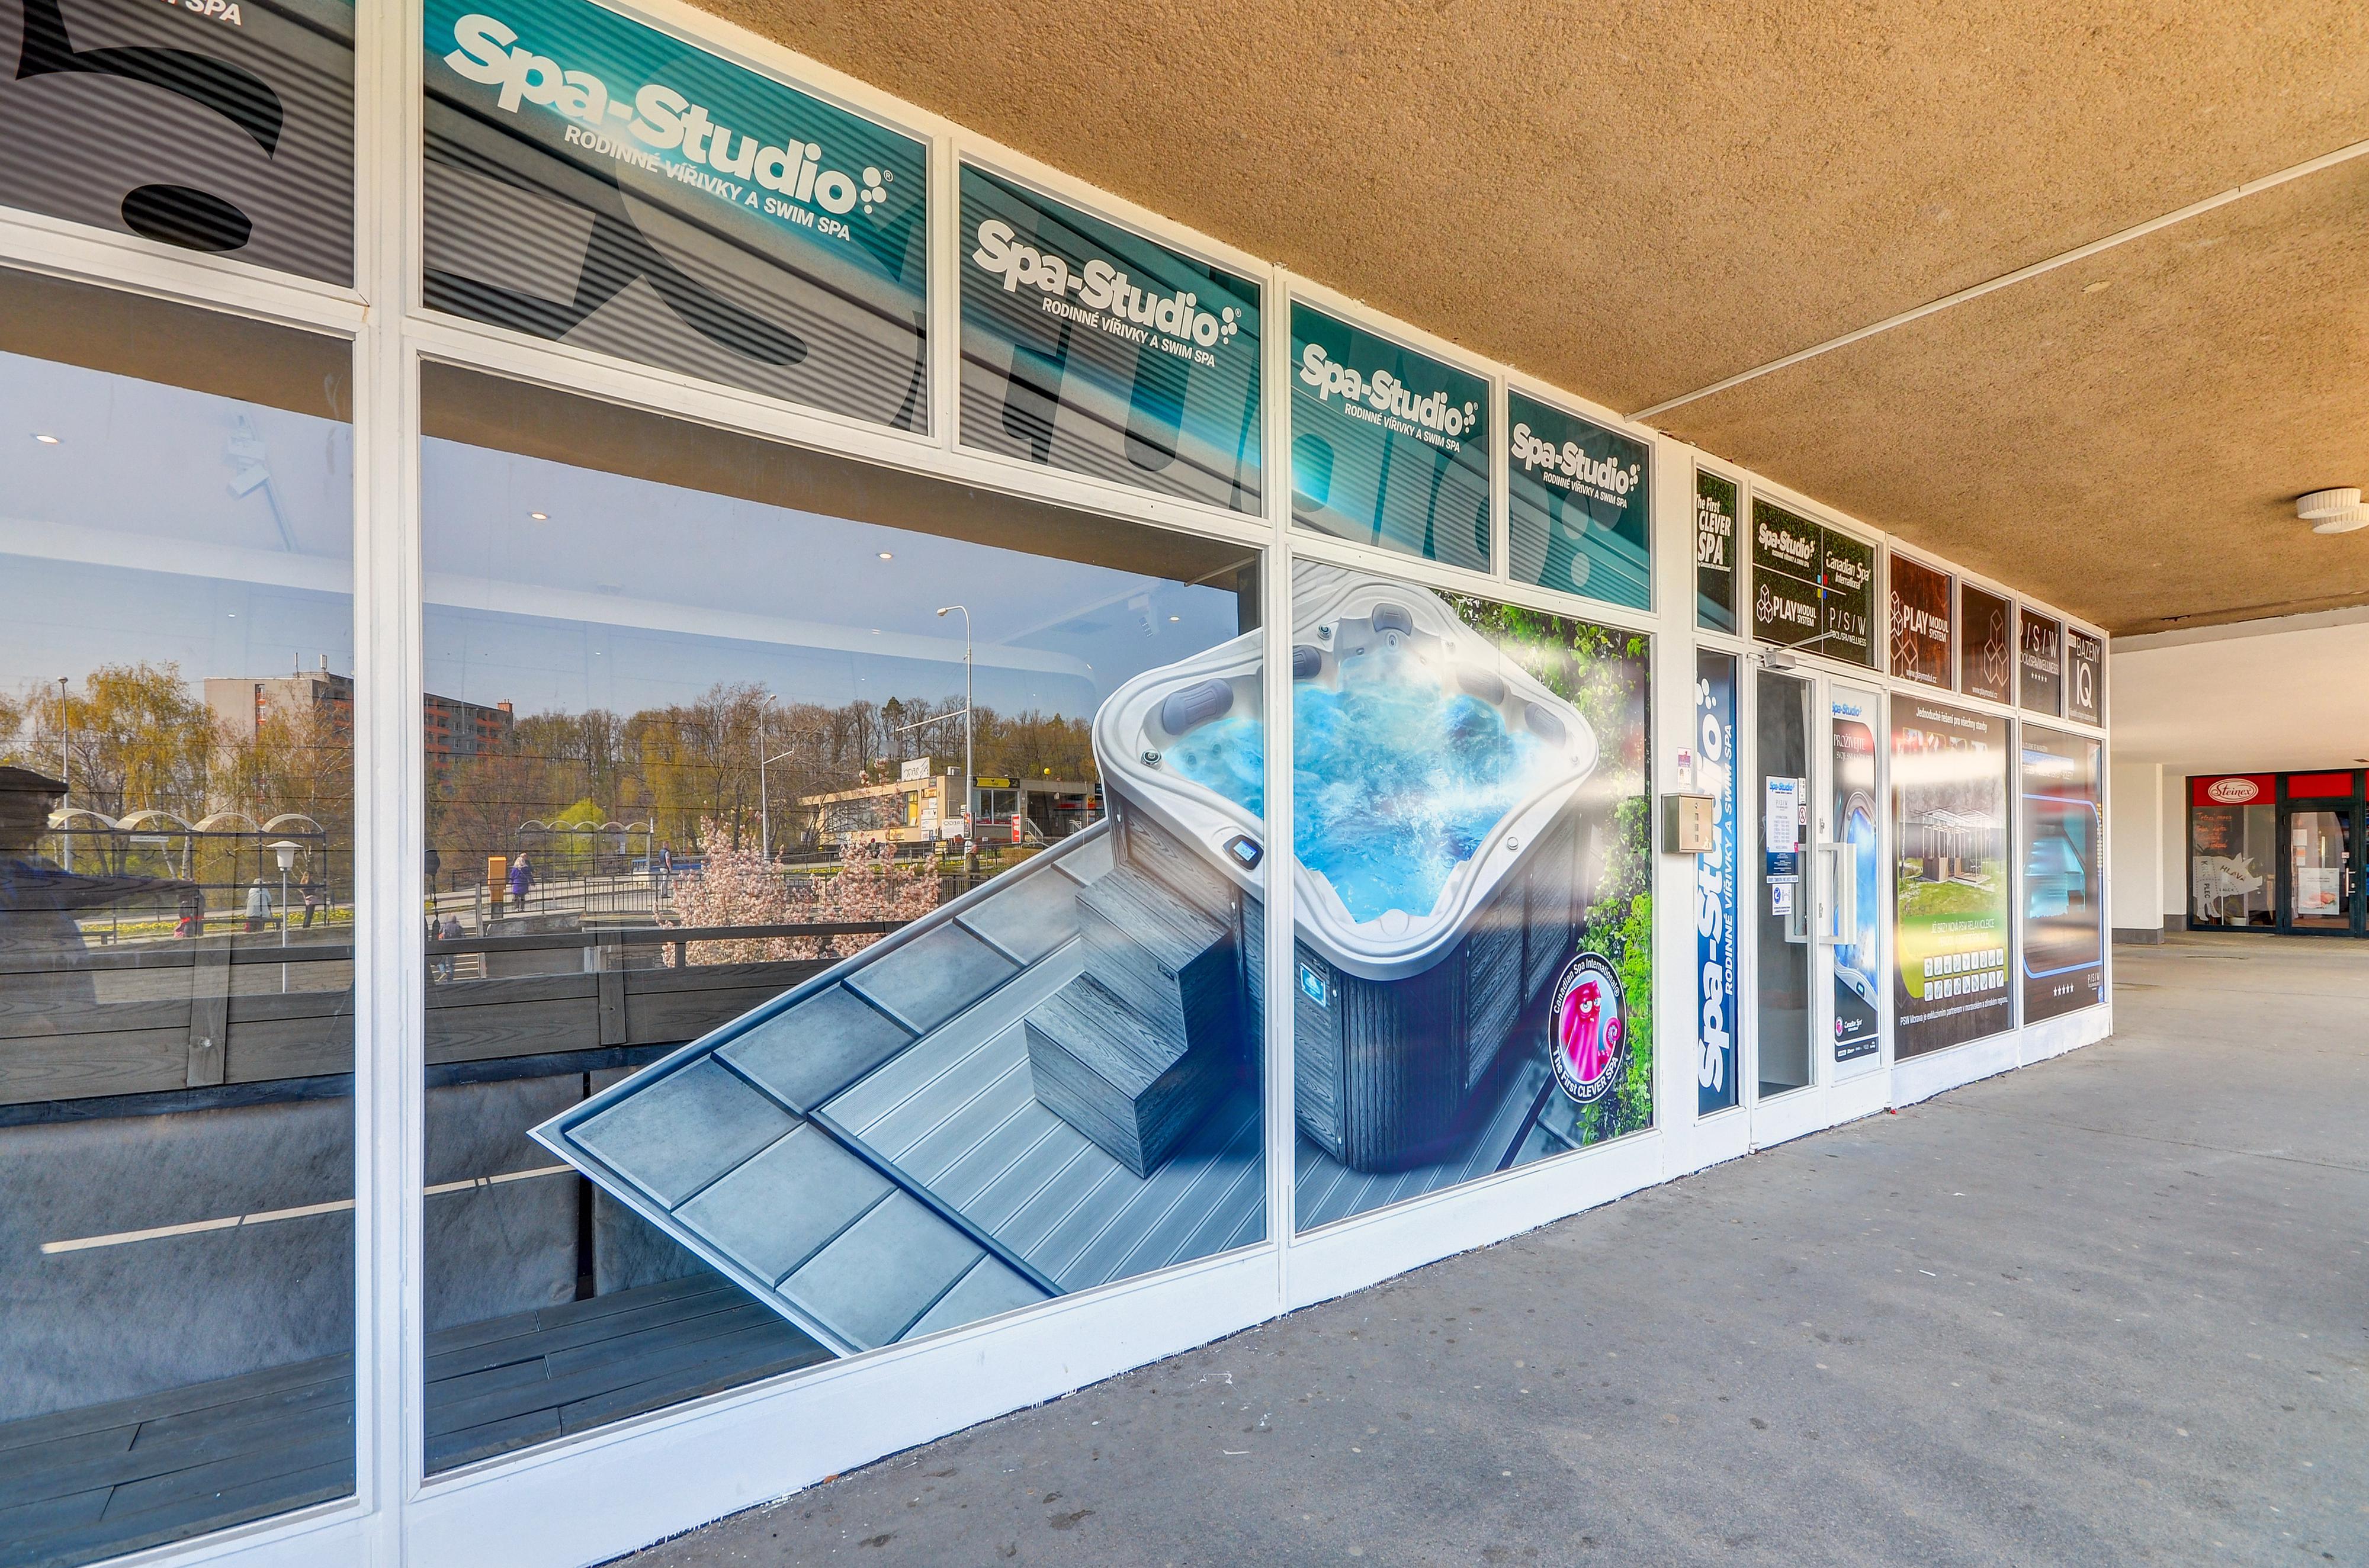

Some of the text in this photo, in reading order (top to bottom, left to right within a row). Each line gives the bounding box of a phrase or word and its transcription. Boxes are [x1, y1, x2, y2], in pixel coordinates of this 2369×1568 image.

[185, 0, 242, 25] SPA
[444, 14, 856, 214] Spa-Studio
[564, 124, 850, 242] RODINNÉ VÍŘIVKY A SWIM SPA
[971, 219, 1218, 347] Spa-Studio
[1042, 297, 1215, 367] RODINNÉ VÍŘIVKY A SWIM SPA
[1299, 343, 1462, 436] Spa-Studio
[1344, 403, 1460, 453] RODINNÉ VÍŘIVKY A SWIM SPA
[1511, 422, 1629, 494] Spa-Studio
[1543, 471, 1628, 509] RODINNÉ VÍŘIVKY A SWIM SPA
[1706, 497, 1720, 513] First
[1699, 510, 1731, 536] CLEVER
[1697, 532, 1723, 564] SPA
[1758, 523, 1810, 560] Spa-Studio
[1826, 551, 1869, 583] Canadian Spa
[1835, 571, 1861, 590] International
[1773, 596, 1816, 622] PLAY MODUL
[1797, 615, 1815, 627] SYSTEM
[1903, 605, 1949, 635] PLAY MODUL
[1929, 629, 1947, 642] SYSTEM
[2077, 637, 2100, 663] BAZÉNY
[2076, 660, 2092, 709] IQ
[1916, 706, 1941, 721] Jednoduché
[1941, 712, 1953, 724] řešení
[1960, 716, 1976, 731] všechny
[1976, 721, 1988, 734] stavby
[1834, 734, 1866, 752] PROŽÍVEJTE
[2211, 783, 2252, 798] Steinex
[1724, 724, 1734, 995] RODINNÉ VÍŘIVKY A SWIM SPA
[1553, 970, 1575, 1014] Canadian
[1574, 961, 1586, 977] Spa
[1900, 1016, 1910, 1026] PSW
[1910, 1014, 1923, 1024] Morava
[1923, 1014, 1927, 1023] je
[1552, 1046, 1619, 1098] The First CLEVER SPA
